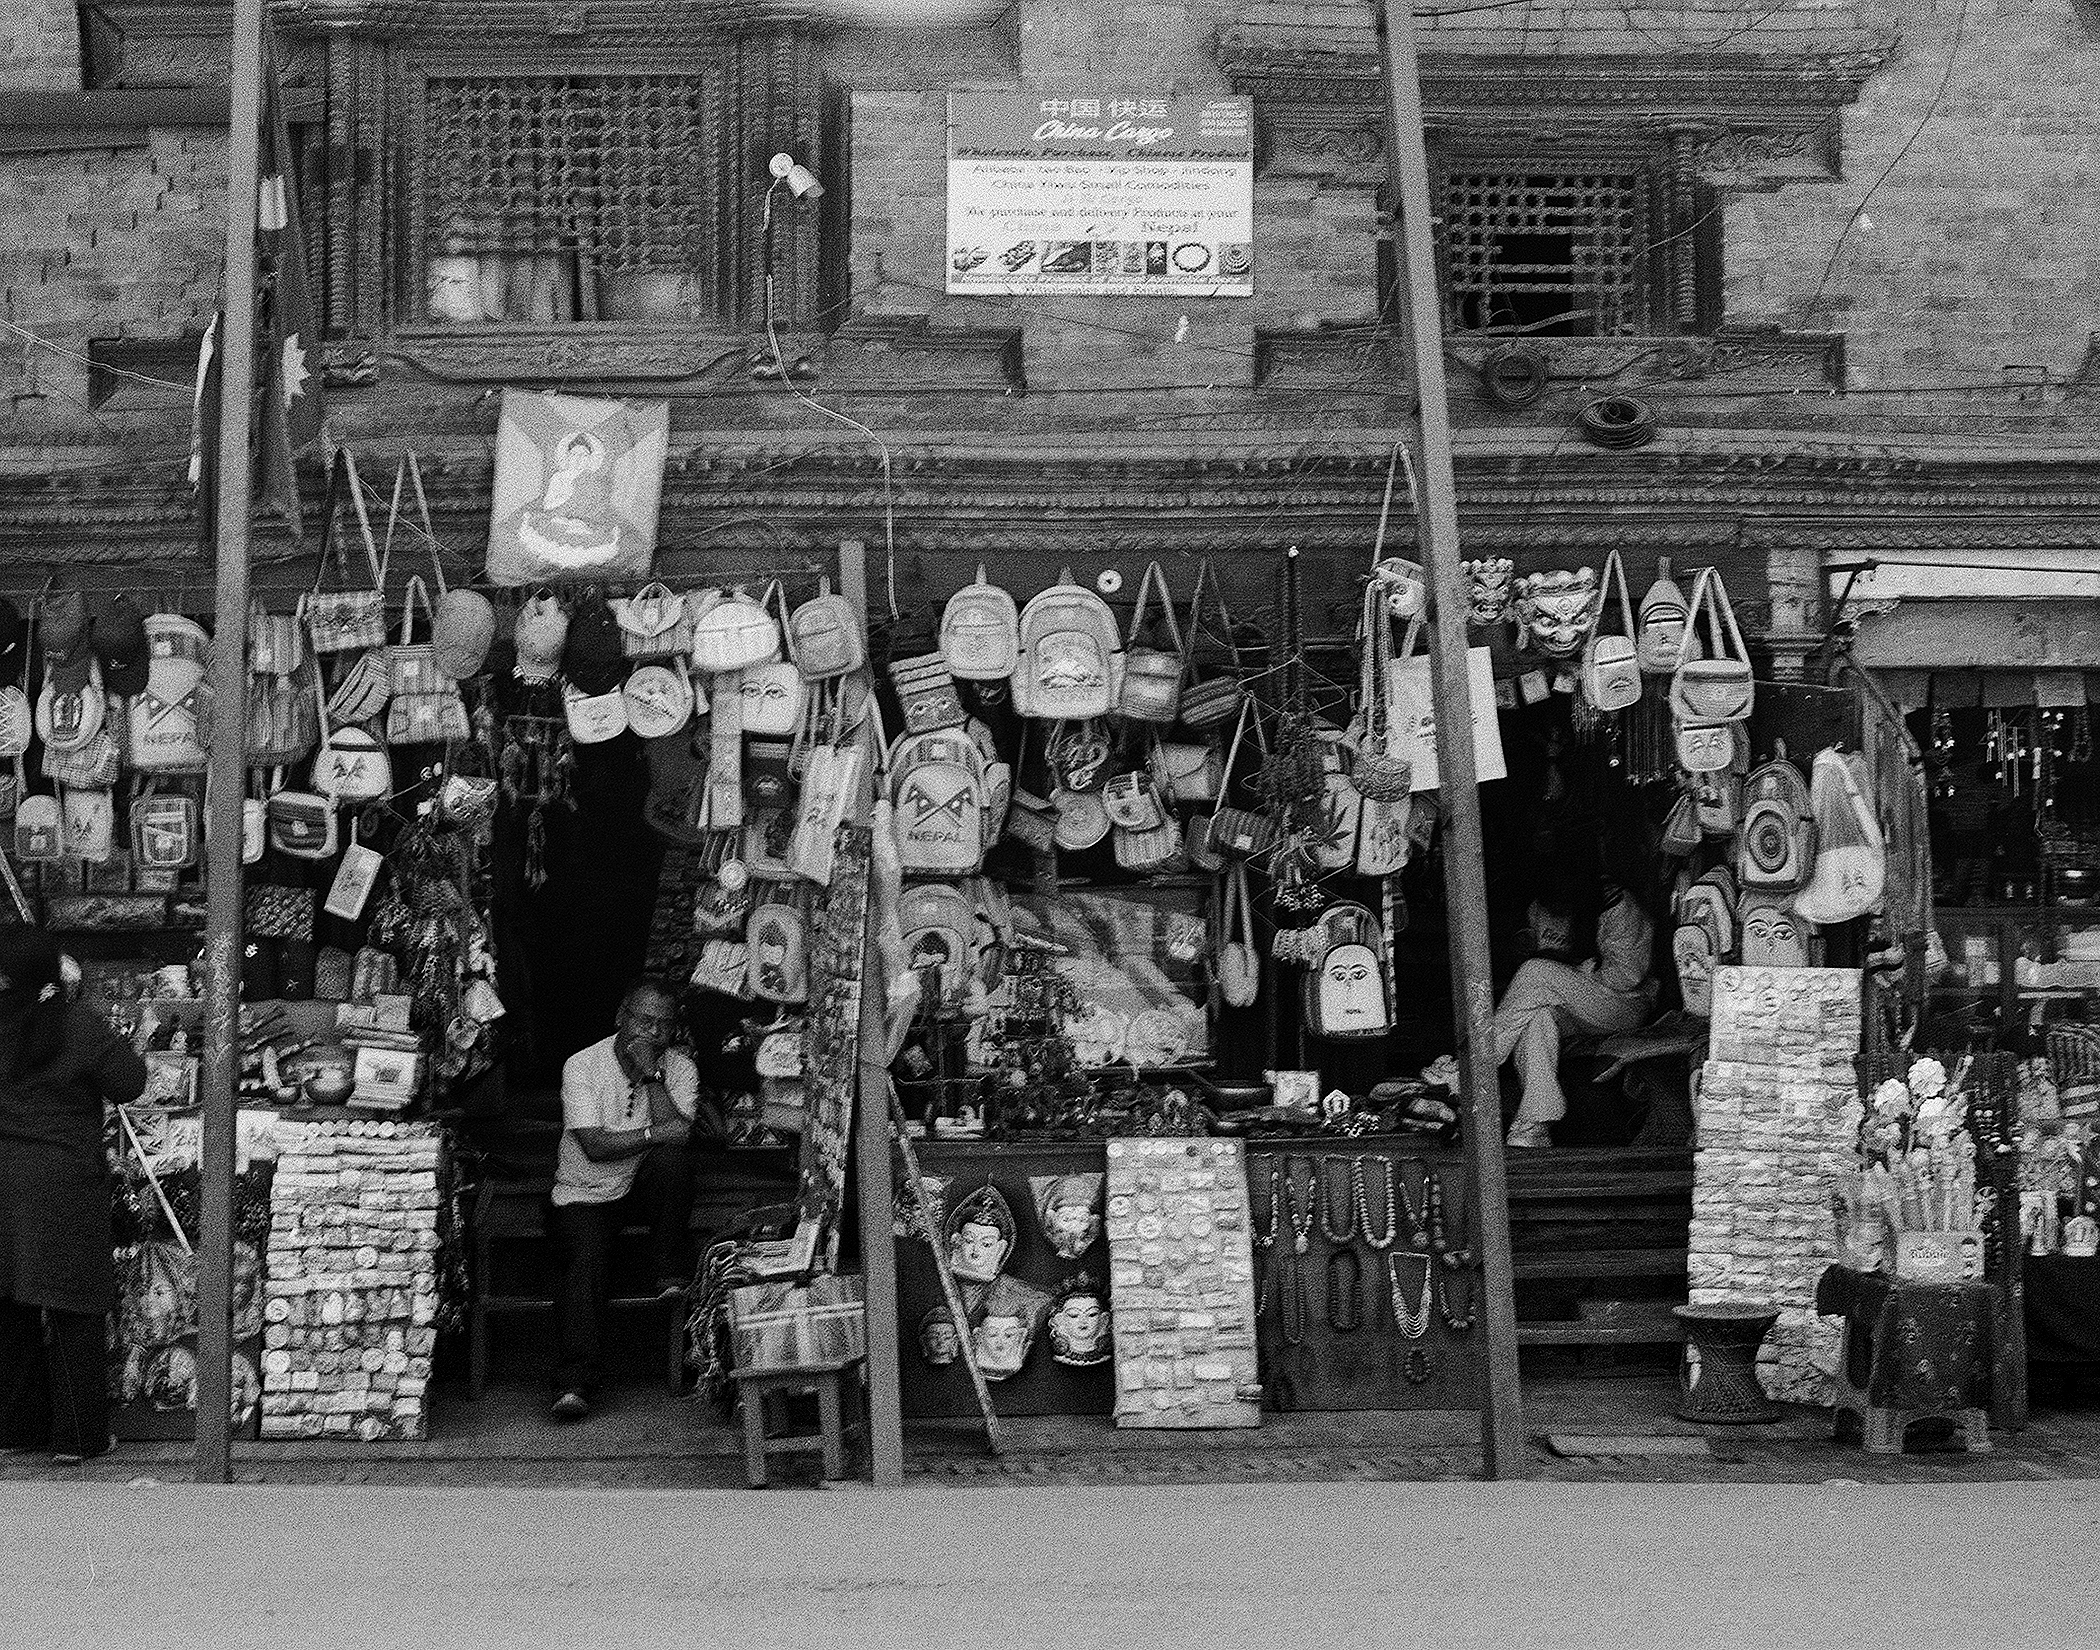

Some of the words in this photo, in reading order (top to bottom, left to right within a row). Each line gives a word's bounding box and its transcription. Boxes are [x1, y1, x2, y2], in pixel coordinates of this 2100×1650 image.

[1040, 98, 1100, 118] 中国
[1107, 98, 1168, 118] 快运
[1032, 119, 1103, 141] China
[1104, 120, 1174, 146] Cargo
[1041, 148, 1115, 159] Purchase,
[1127, 149, 1184, 158] Chinese
[1079, 180, 1121, 190] Small
[1051, 207, 1075, 217] and
[1141, 219, 1199, 237] Nepal
[143, 731, 196, 746] NEPA
[907, 830, 964, 843] NEPAL
